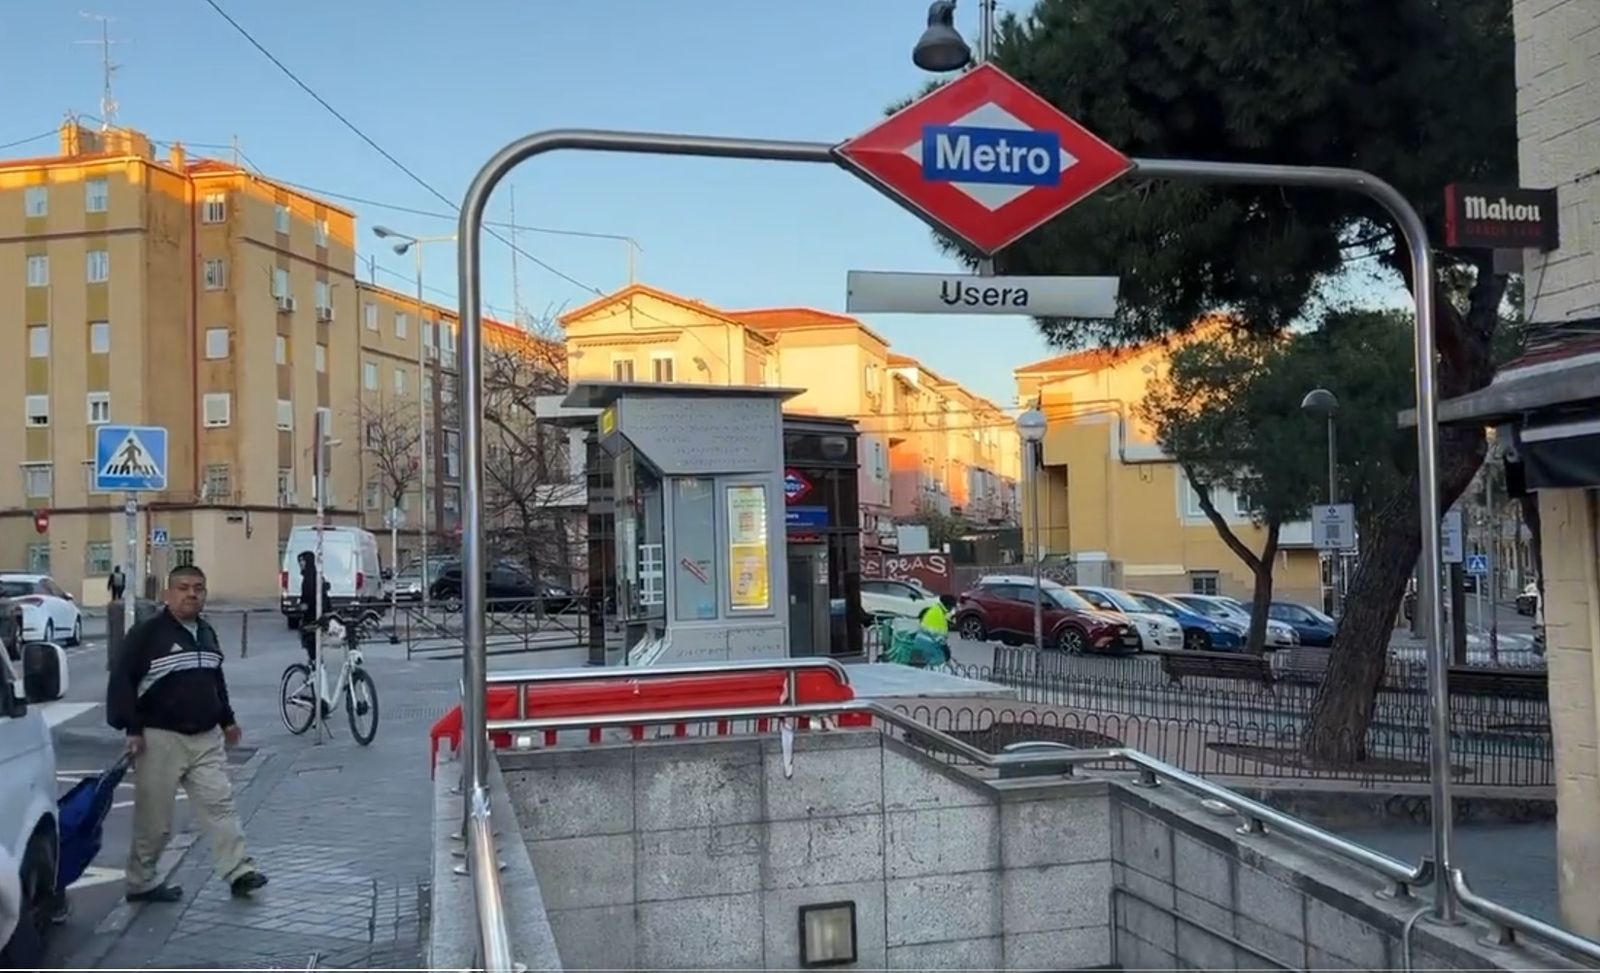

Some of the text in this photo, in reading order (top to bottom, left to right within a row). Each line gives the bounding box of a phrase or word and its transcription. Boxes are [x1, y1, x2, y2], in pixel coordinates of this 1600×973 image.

[935, 133, 1051, 175] Metro
[1464, 196, 1541, 222] Mahou
[940, 280, 1029, 306] Usera
